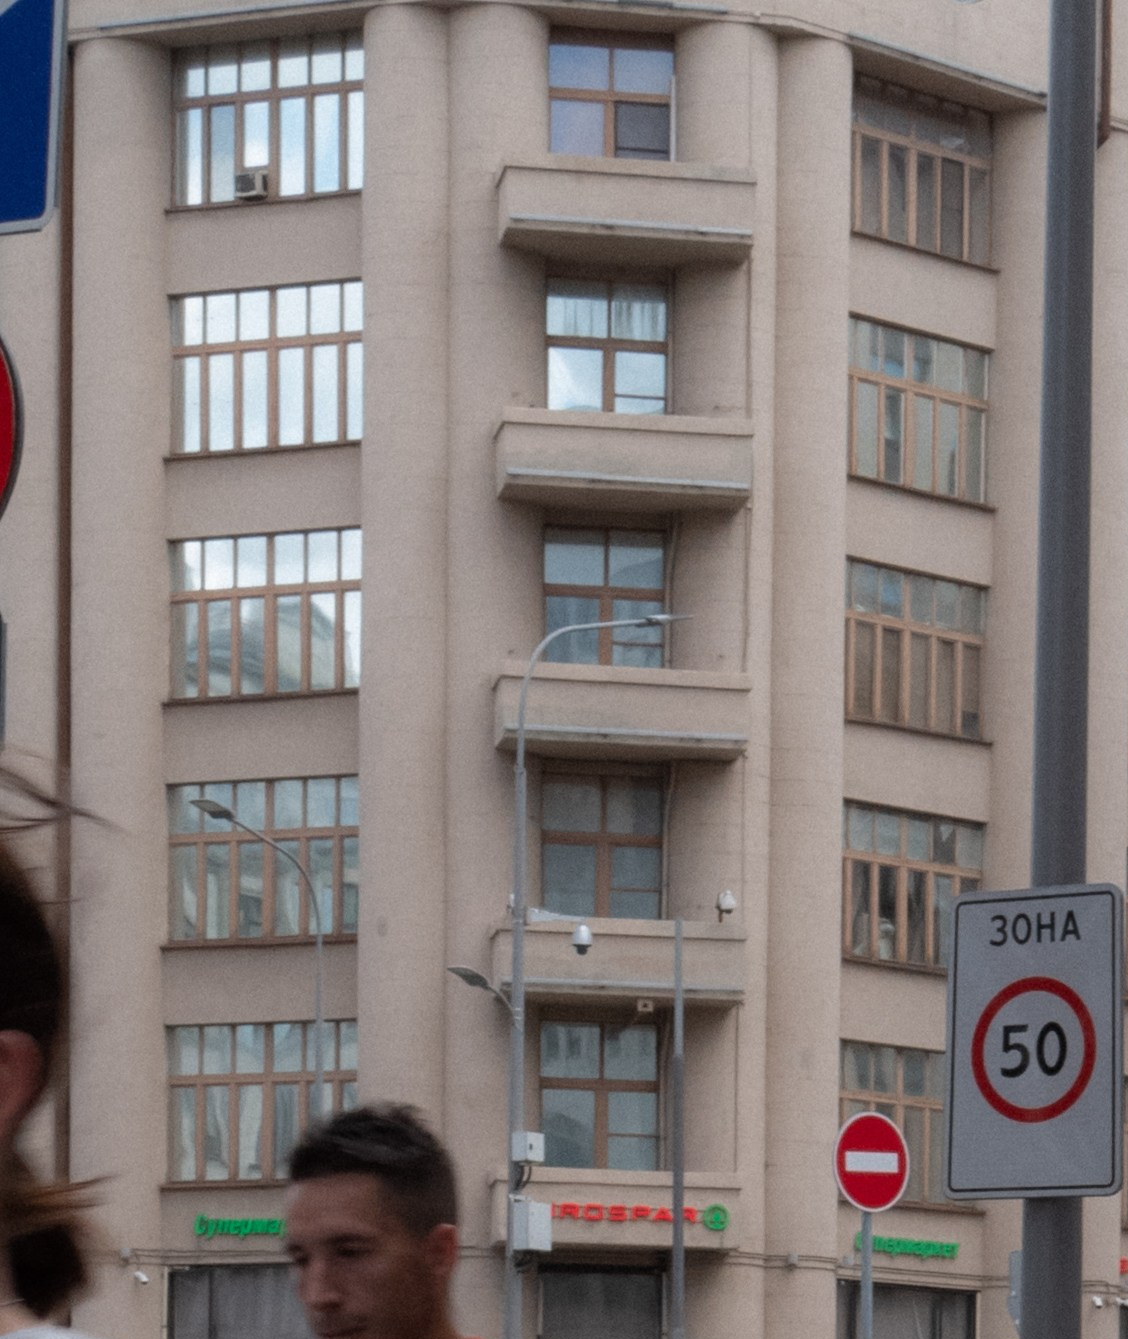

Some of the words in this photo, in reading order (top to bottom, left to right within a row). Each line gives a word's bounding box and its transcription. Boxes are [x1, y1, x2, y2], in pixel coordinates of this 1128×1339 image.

[989, 910, 1081, 947] ЗОНА
[1000, 1021, 1067, 1078] 50
[552, 1202, 697, 1225] ROSPAR
